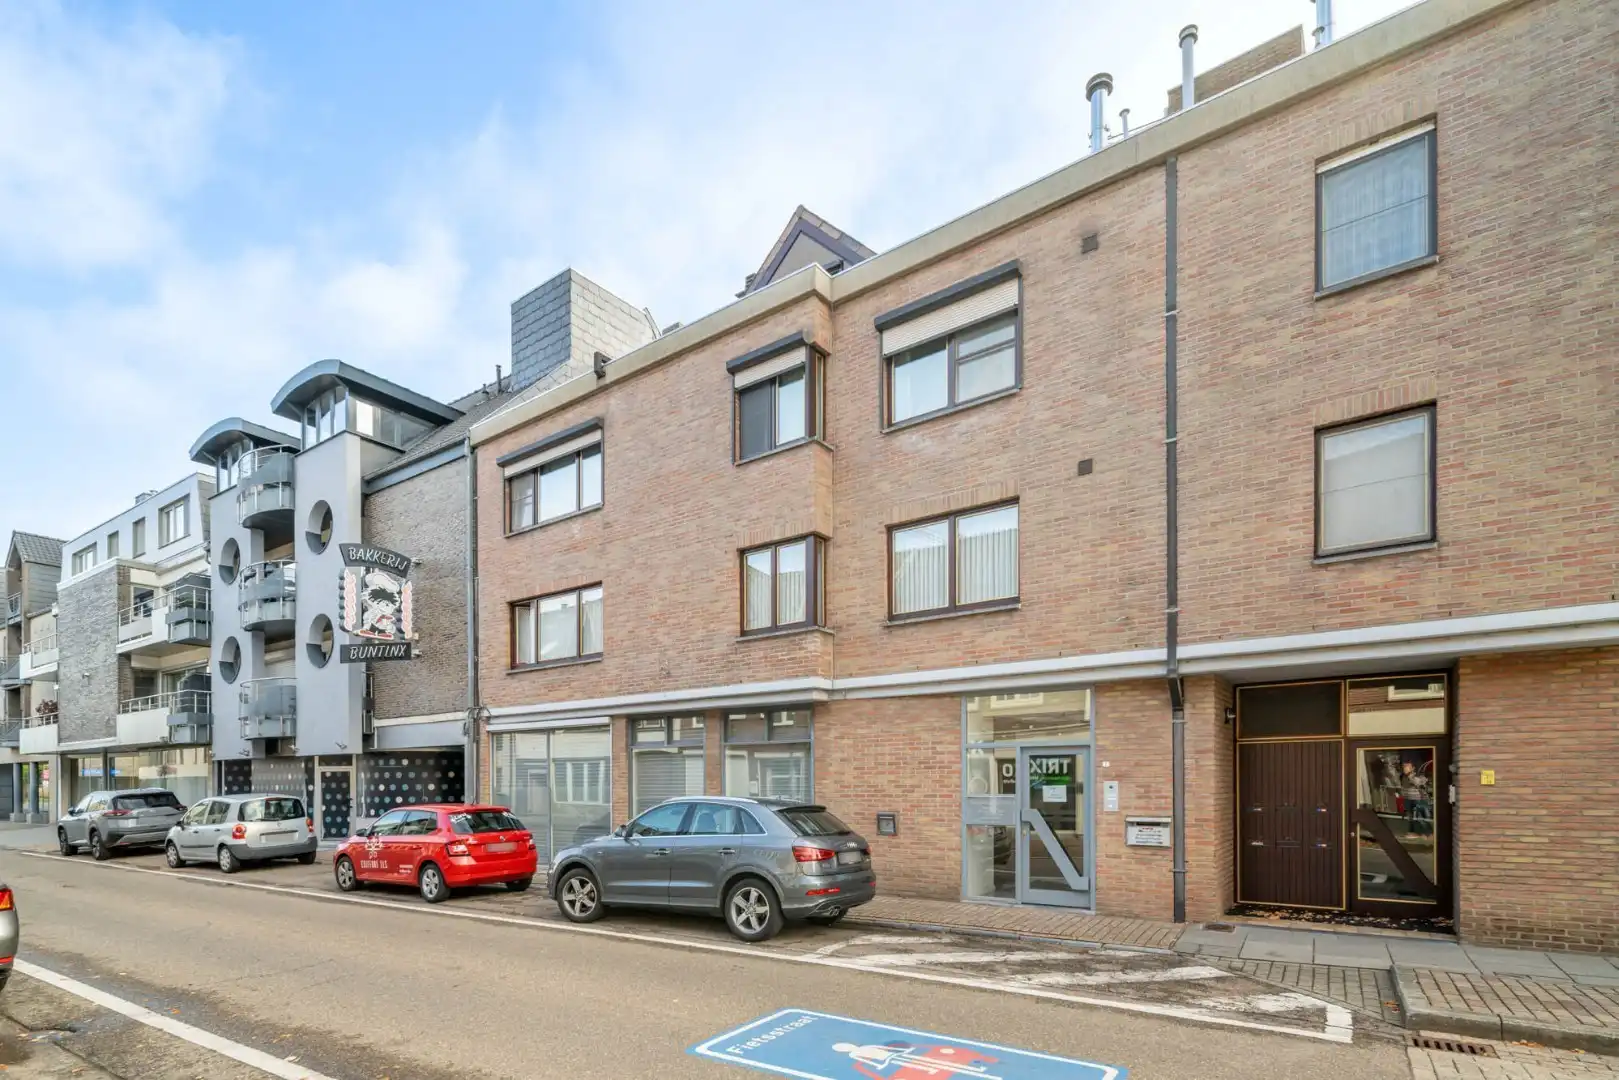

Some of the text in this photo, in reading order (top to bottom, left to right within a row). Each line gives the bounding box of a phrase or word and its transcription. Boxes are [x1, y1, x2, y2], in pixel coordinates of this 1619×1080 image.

[348, 546, 408, 570] BAKKERIJ
[350, 645, 407, 660] BUNTINX
[725, 1015, 819, 1056] Fietsstraat
